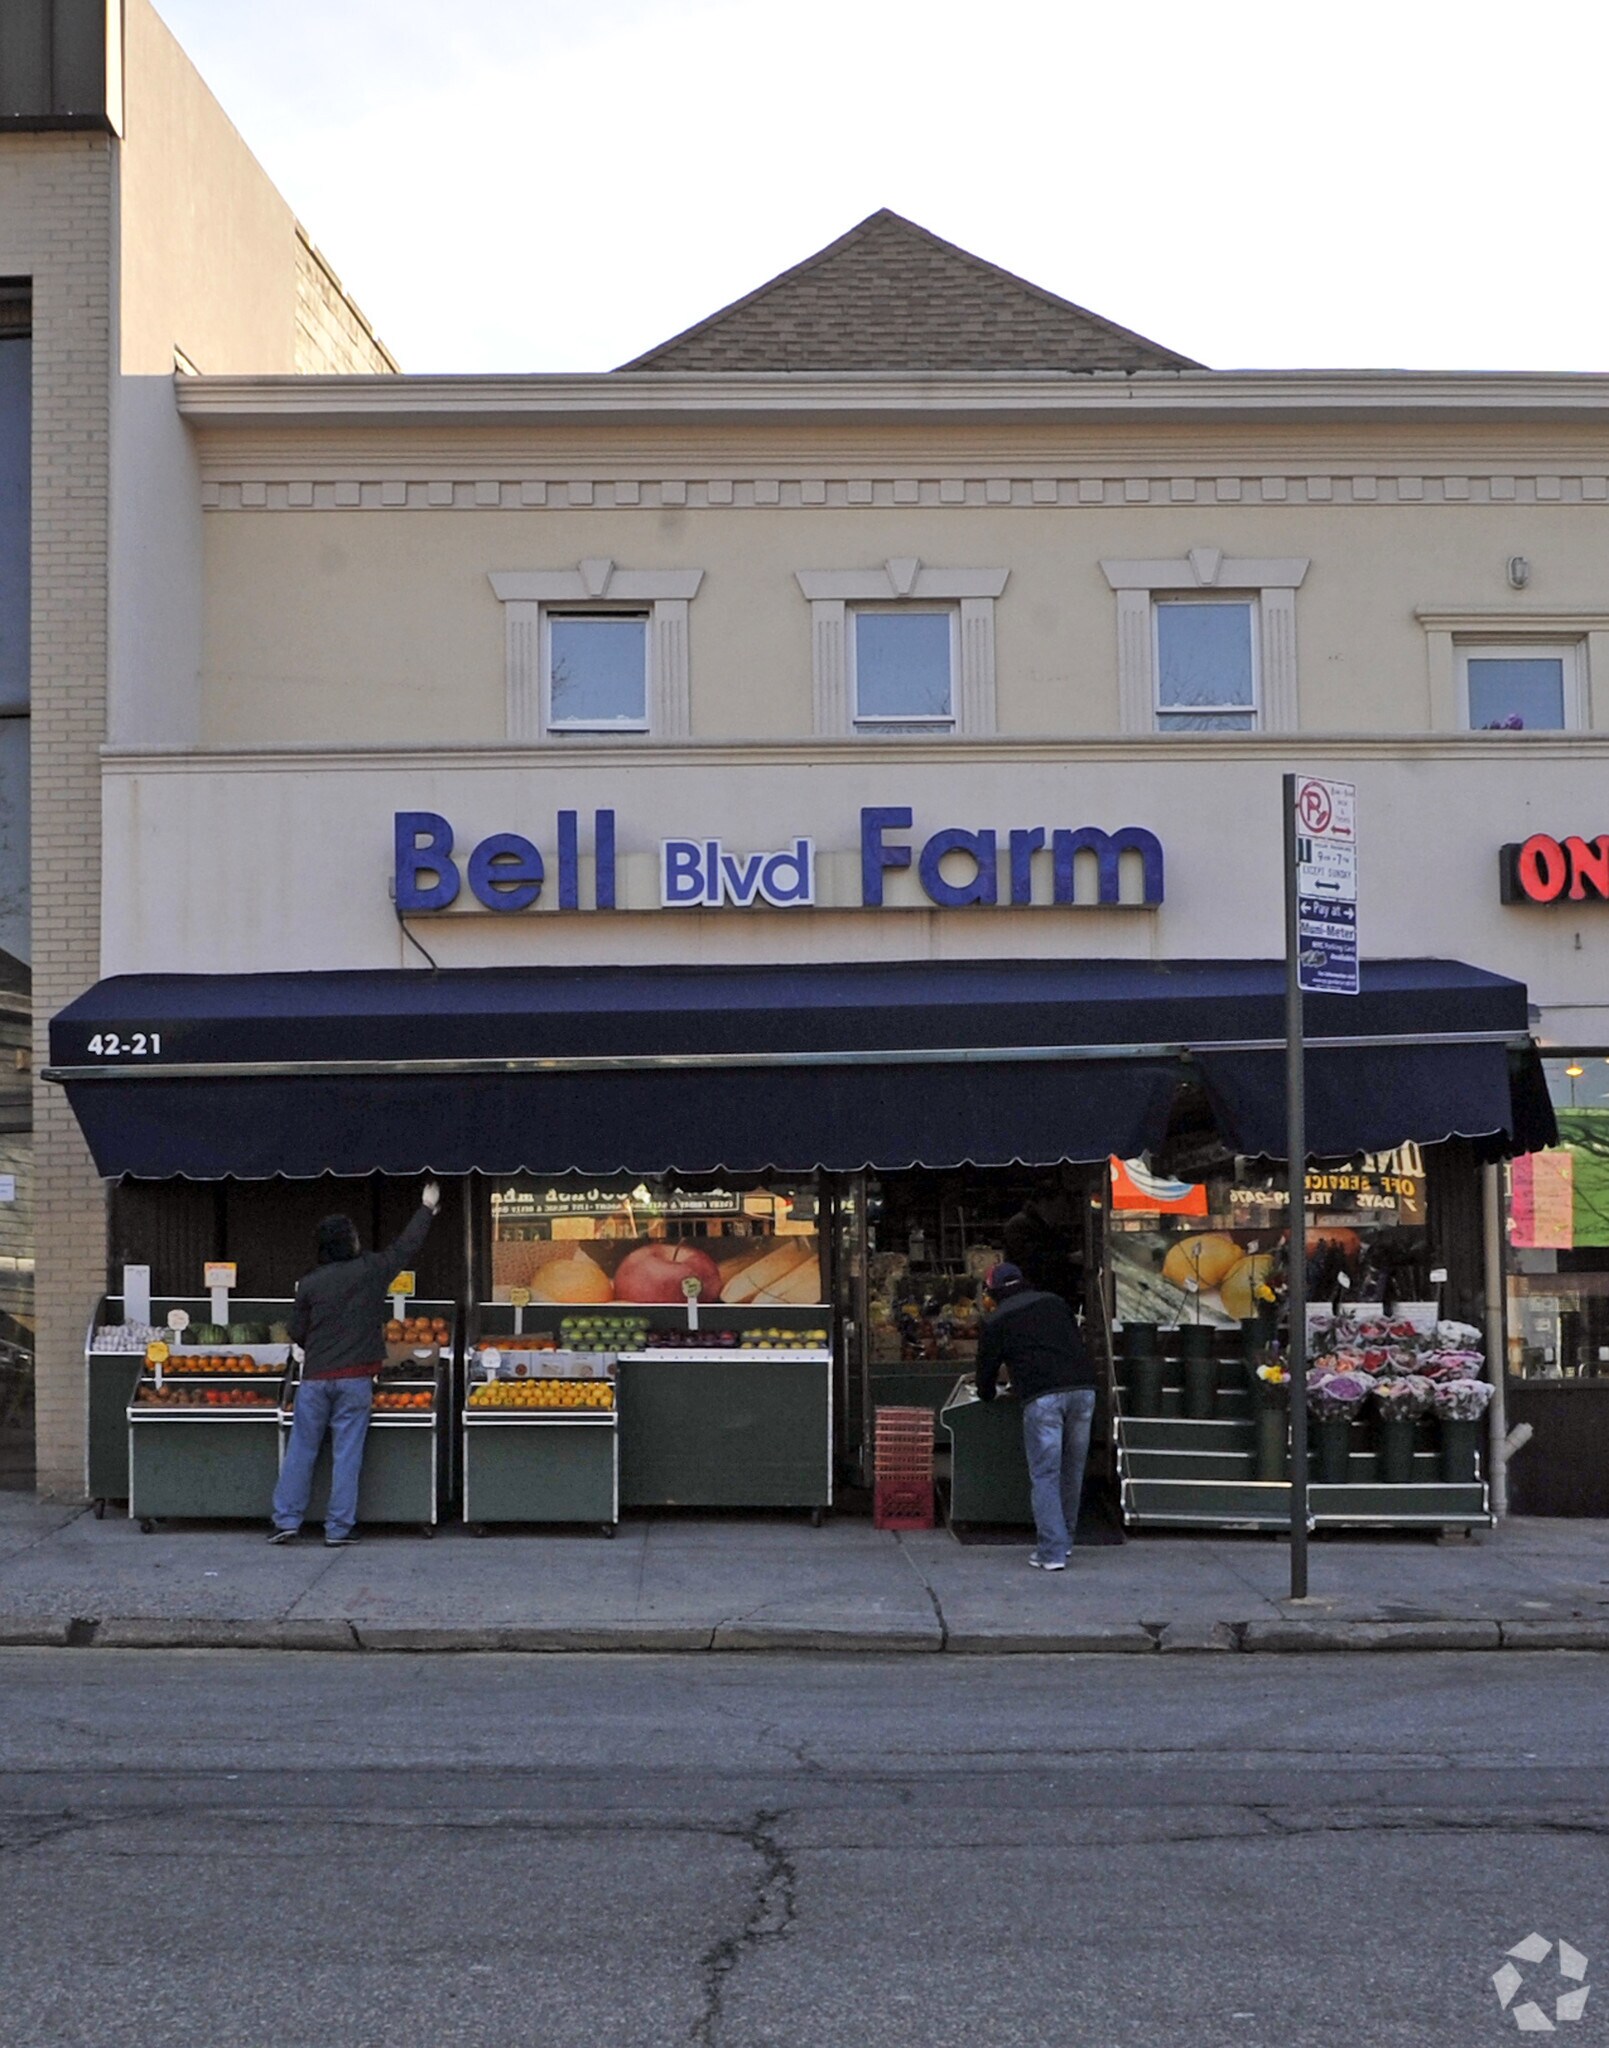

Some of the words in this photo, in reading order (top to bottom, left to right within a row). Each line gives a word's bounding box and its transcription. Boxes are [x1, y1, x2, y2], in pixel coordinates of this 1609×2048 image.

[394, 808, 616, 912] Bell
[663, 838, 814, 906] Blvd
[860, 807, 1164, 909] Farm
[1518, 832, 1609, 903] ON
[1313, 900, 1330, 918] Pay
[87, 1032, 161, 1056] 42-21
